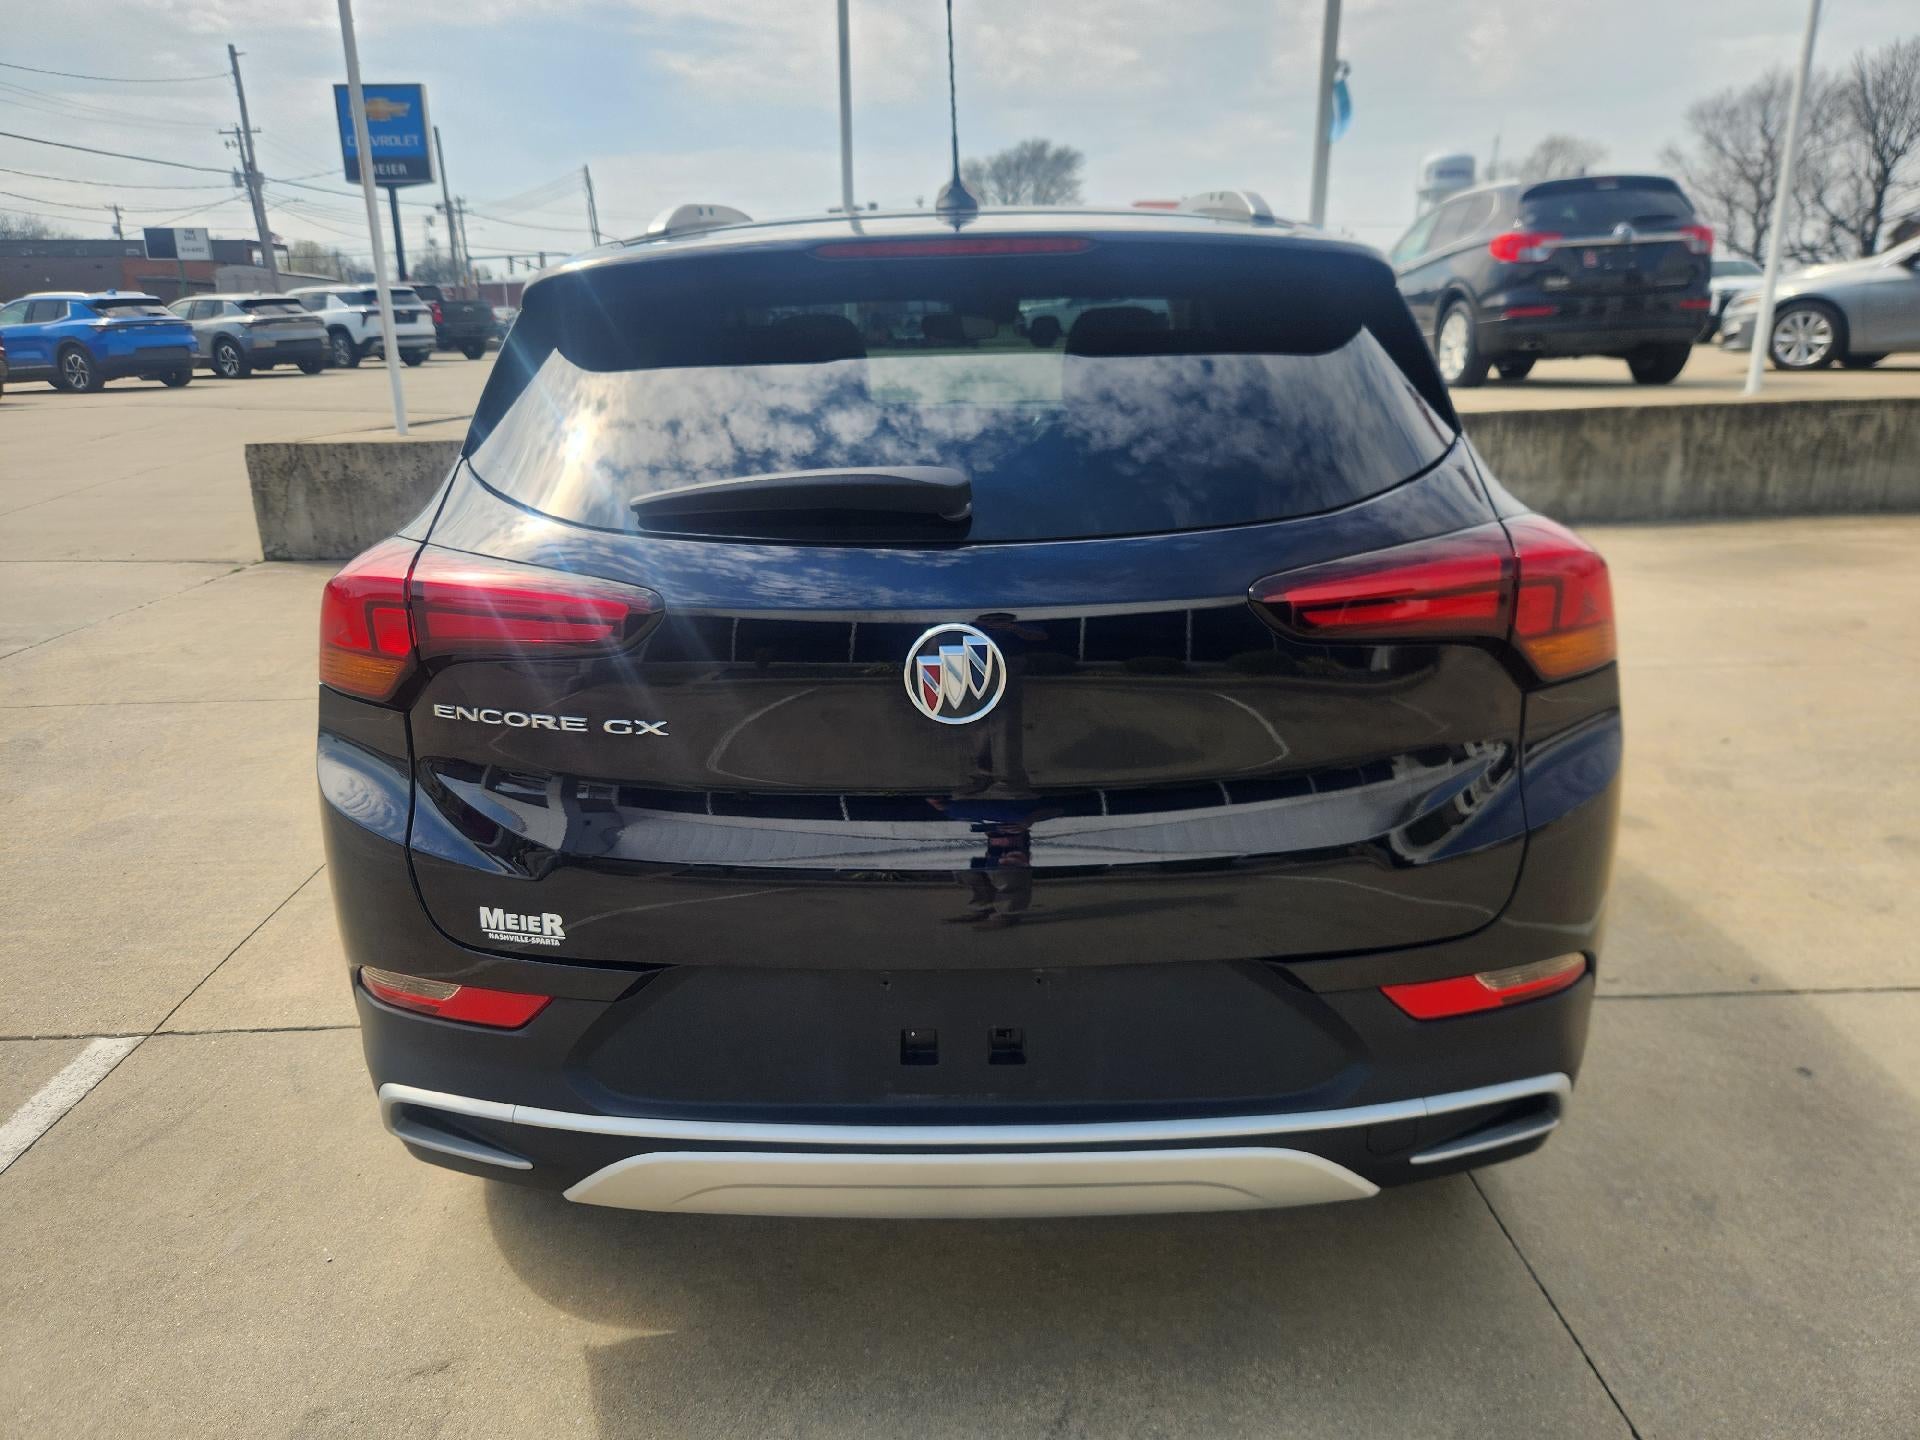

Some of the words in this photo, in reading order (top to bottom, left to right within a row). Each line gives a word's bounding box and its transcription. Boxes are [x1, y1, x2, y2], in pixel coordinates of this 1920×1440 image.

[346, 134, 419, 147] CVROLET
[433, 703, 589, 733] ENCORE
[602, 718, 670, 736] GX
